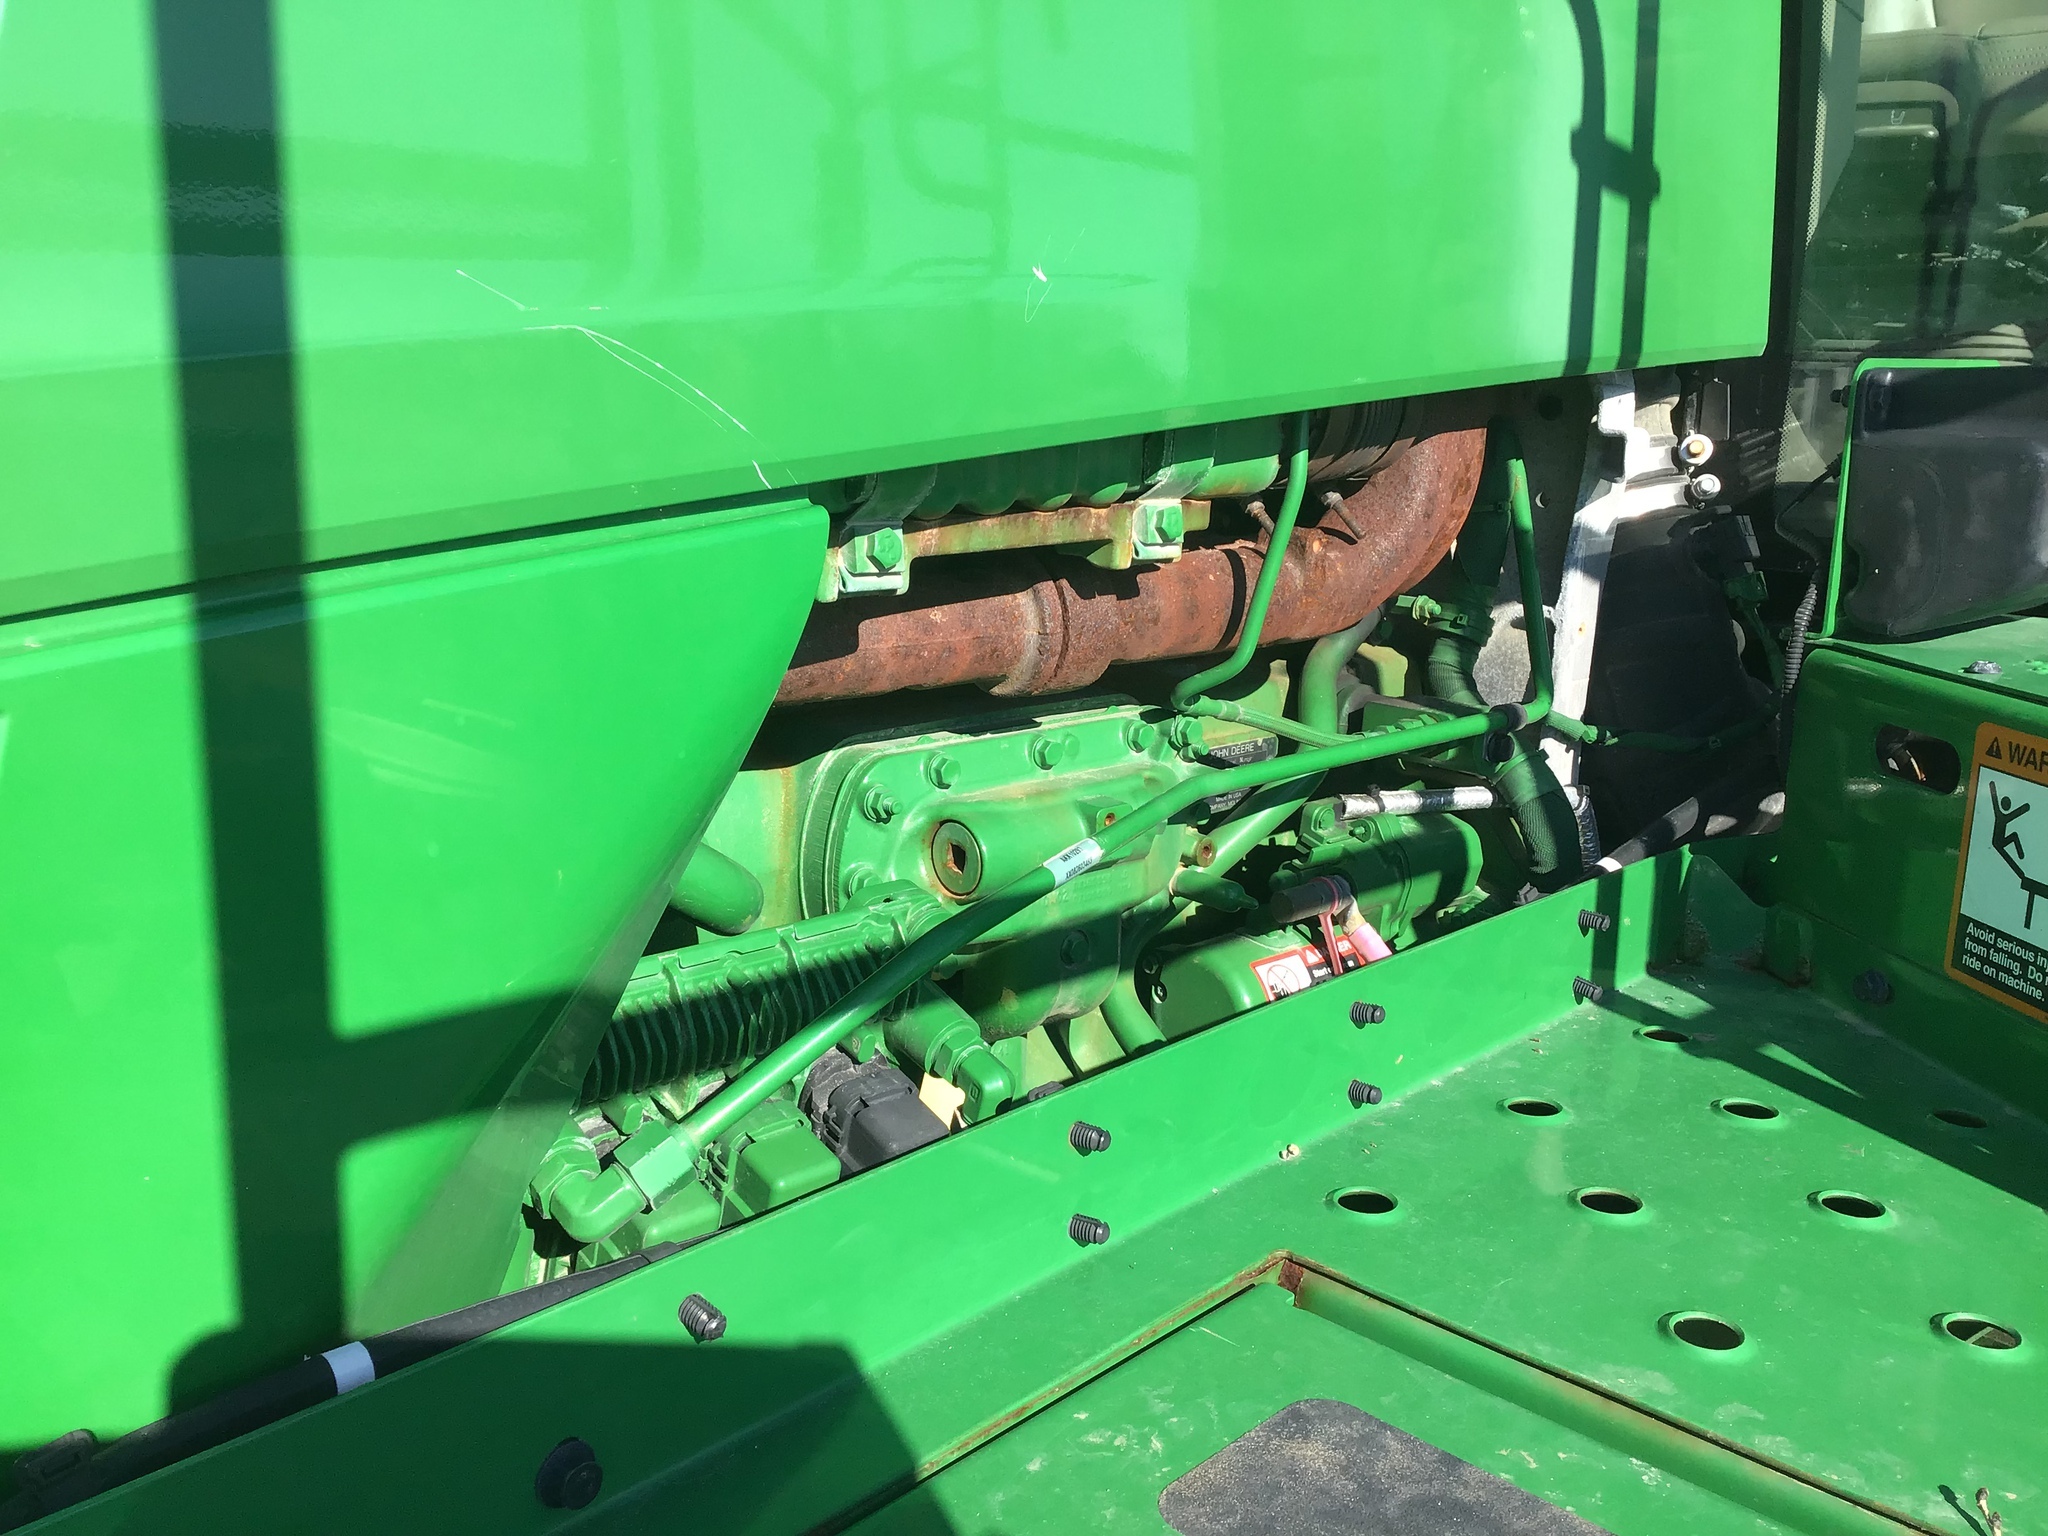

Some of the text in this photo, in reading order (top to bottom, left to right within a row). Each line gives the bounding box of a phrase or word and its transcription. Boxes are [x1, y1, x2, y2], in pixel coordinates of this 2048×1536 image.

[1231, 743, 1254, 755] DEERE
[1964, 937, 1987, 958] from
[1989, 948, 2023, 976] falling.
[2027, 965, 2043, 983] Do
[1966, 922, 1996, 945] Avoid
[1996, 938, 2035, 962] serious
[1962, 954, 1982, 971] ride
[1983, 965, 1996, 979] on
[1998, 971, 2045, 1002] machine.
